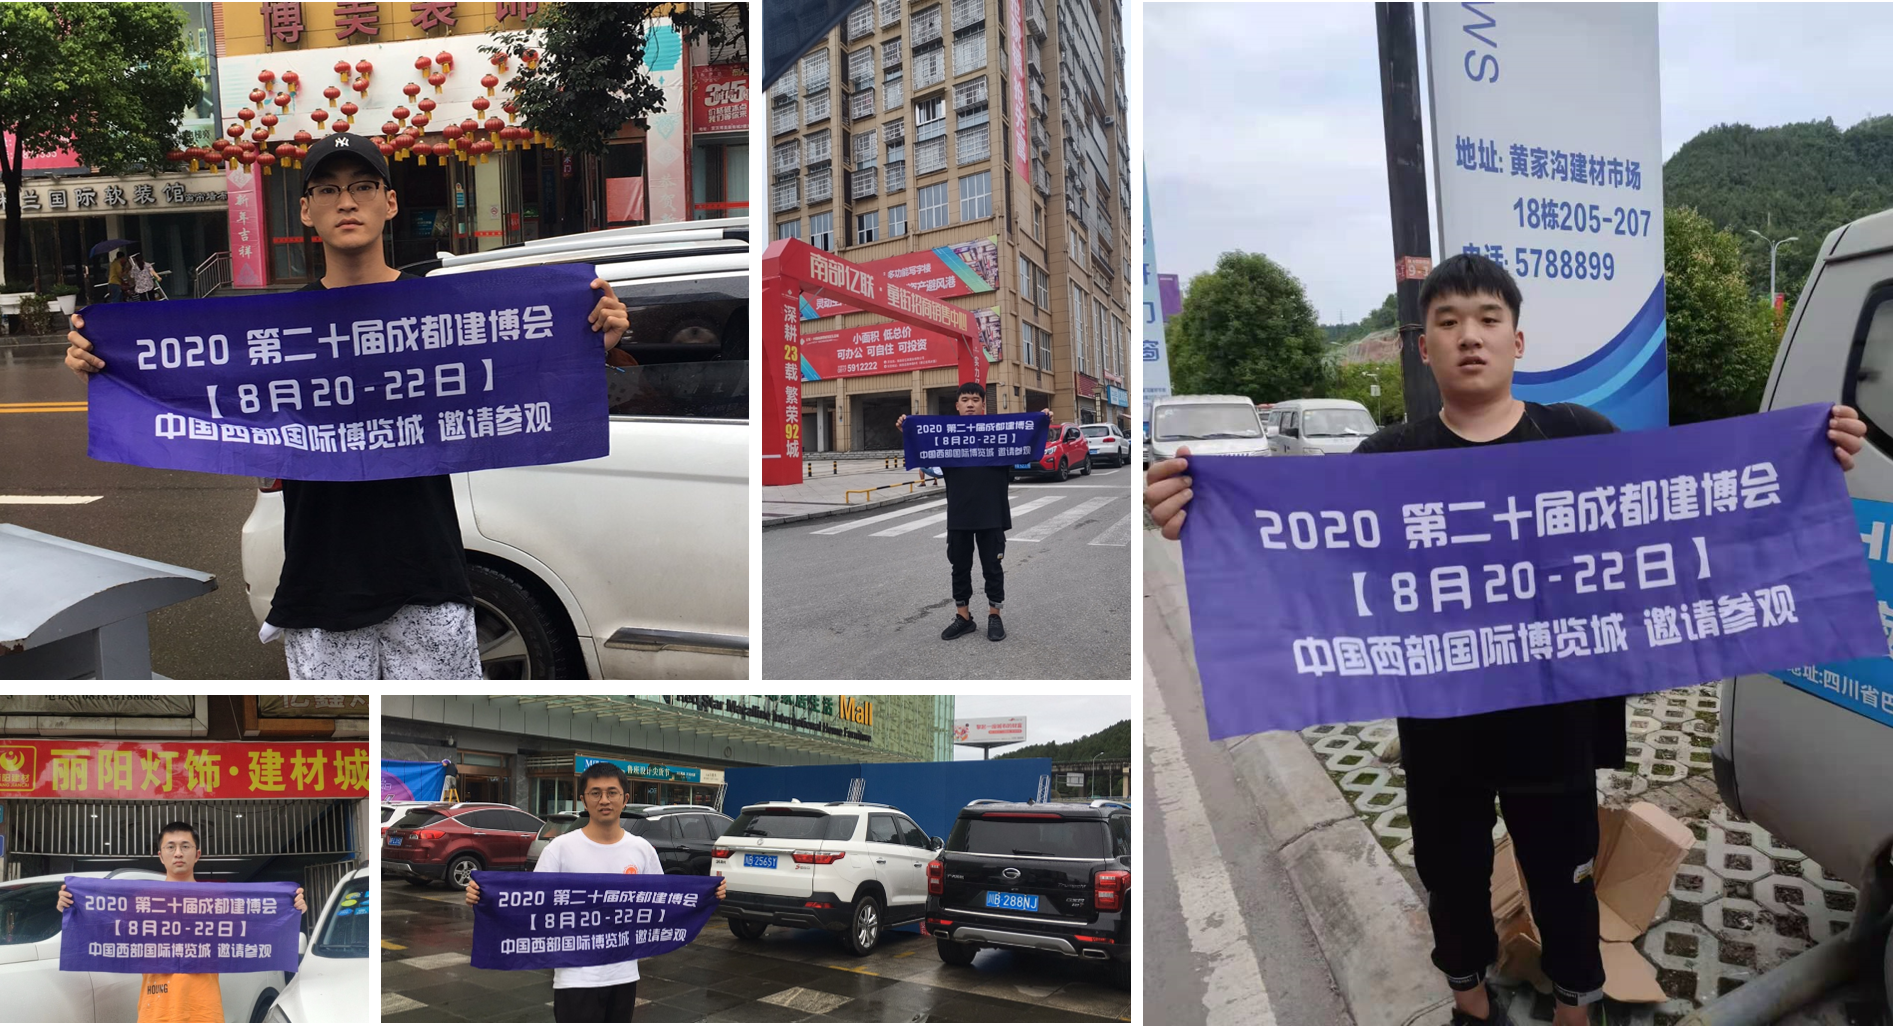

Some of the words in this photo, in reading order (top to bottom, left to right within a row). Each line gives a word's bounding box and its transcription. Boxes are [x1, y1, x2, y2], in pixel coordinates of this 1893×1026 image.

[704, 80, 747, 107] 315
[1509, 144, 1641, 190] 黄家沟建材市场
[235, 194, 252, 259] 新年吉祥
[1513, 197, 1651, 237] 18栋205-207
[887, 263, 931, 279] 多功能写字楼
[1515, 248, 1615, 281] 5788899
[137, 333, 230, 371] 2020
[247, 304, 554, 366] 第二十届成都建博会
[837, 348, 863, 360] 可办公
[866, 344, 894, 357] 可自住
[898, 339, 927, 353] 可投资
[853, 331, 879, 345] 小面积
[883, 326, 912, 341] 低总价
[847, 362, 877, 373] 5912222
[155, 412, 425, 453] 中国西部国际博览城
[438, 401, 552, 443] 邀请参观
[917, 424, 942, 434] 2020
[946, 420, 1034, 433] 第二十届成都建博会
[920, 447, 994, 459] 中国西部国际博览城
[998, 446, 1031, 457] 邀请参观
[1255, 507, 1381, 550] 2020
[1402, 461, 1781, 551] 第二十届成都建博会
[1292, 612, 1627, 677] 中国西部国际博览城
[1643, 583, 1799, 650] 邀请参观
[839, 695, 873, 726] Mall
[51, 748, 369, 793] 丽阳灯饰·建材城
[85, 895, 128, 913] 2020
[135, 896, 278, 915] 第二十届成都建博会
[499, 890, 545, 908] 2020
[553, 889, 699, 908] 第二十届成都建博会
[89, 940, 211, 959] 中国西部国际博览城
[217, 942, 272, 959] 邀请参观
[501, 931, 630, 955] 中国西部国际博览城
[635, 927, 687, 944] 邀请参观
